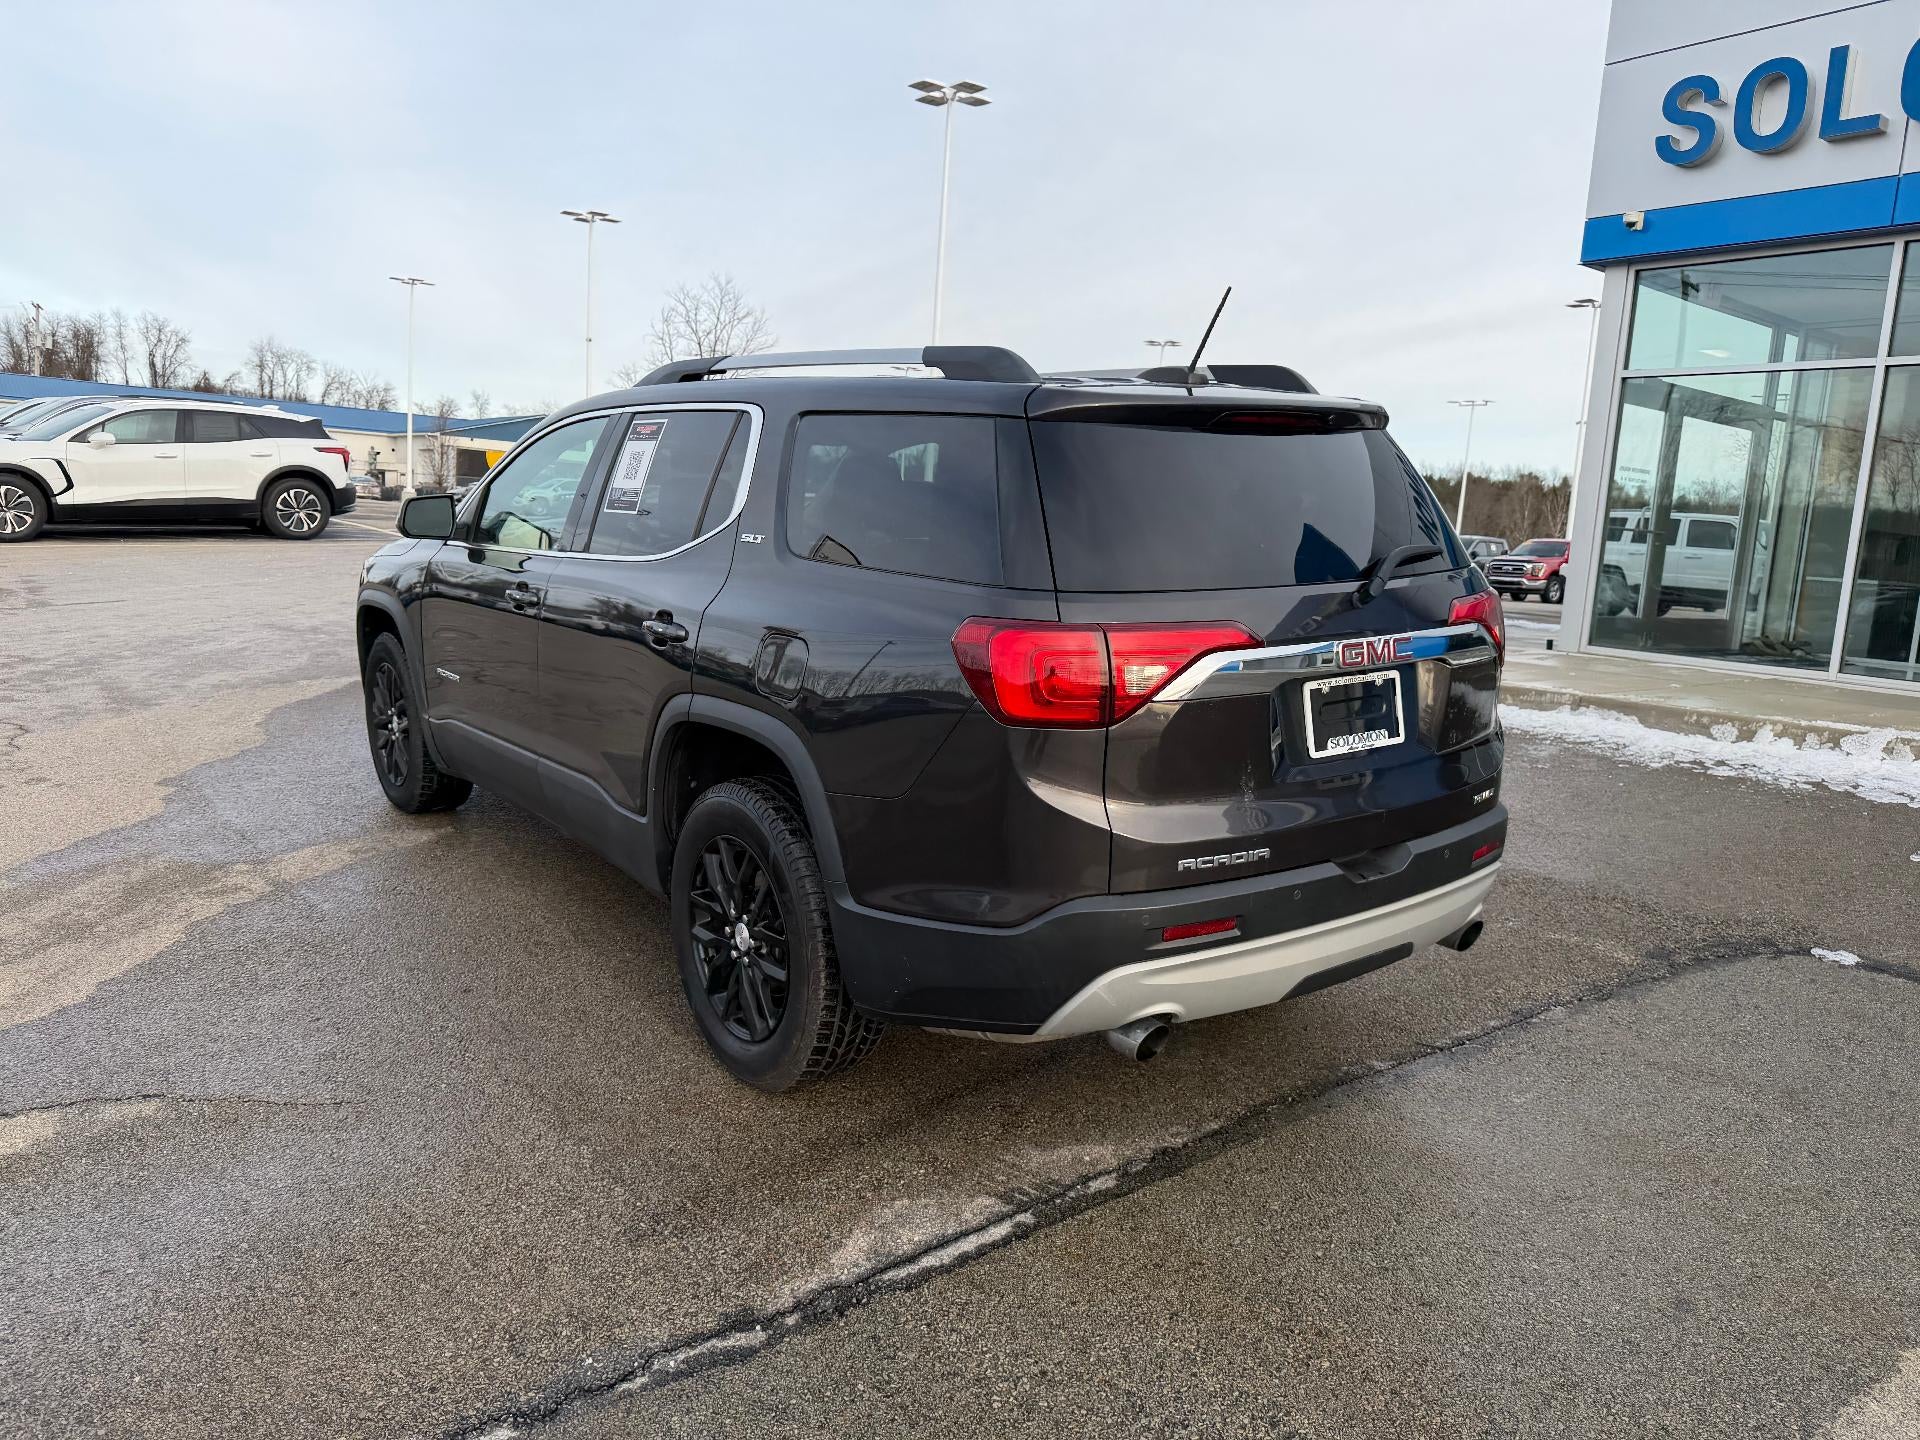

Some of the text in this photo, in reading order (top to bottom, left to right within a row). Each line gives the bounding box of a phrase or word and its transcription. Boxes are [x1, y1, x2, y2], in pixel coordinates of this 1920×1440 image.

[1655, 38, 1920, 168] SOL
[741, 534, 765, 544] SLT
[1340, 637, 1413, 667] GMC
[1330, 730, 1387, 749] SOLOMON
[1178, 848, 1270, 871] ACADIA
